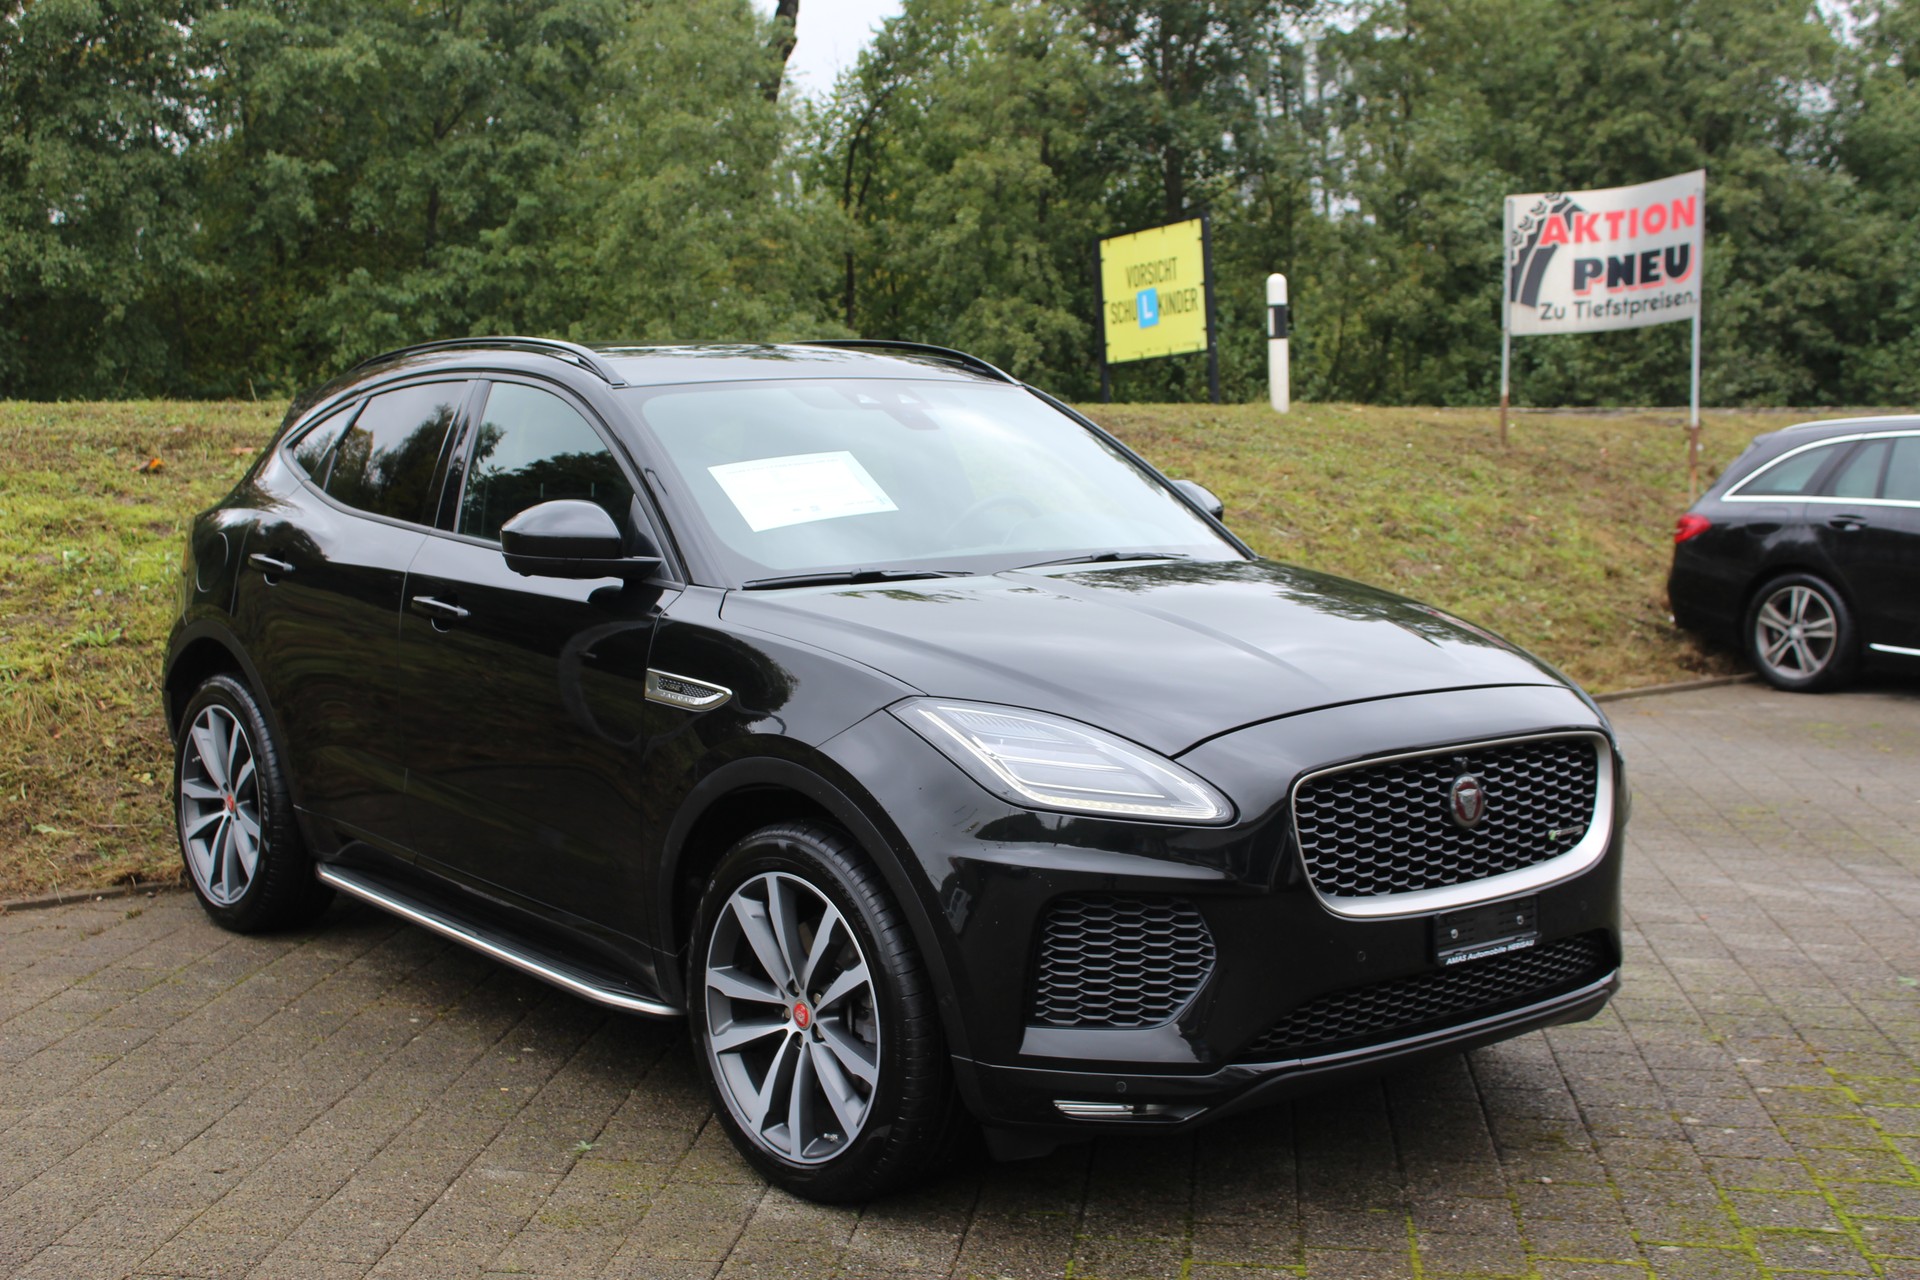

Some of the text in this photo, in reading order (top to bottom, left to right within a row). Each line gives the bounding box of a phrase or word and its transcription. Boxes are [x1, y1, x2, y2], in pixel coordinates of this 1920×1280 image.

[1539, 196, 1696, 245] AKTION
[1126, 257, 1177, 288] VORSICHT
[1572, 242, 1695, 296] PNEU
[1540, 302, 1566, 321] Zu
[1468, 946, 1507, 960] Automobile
